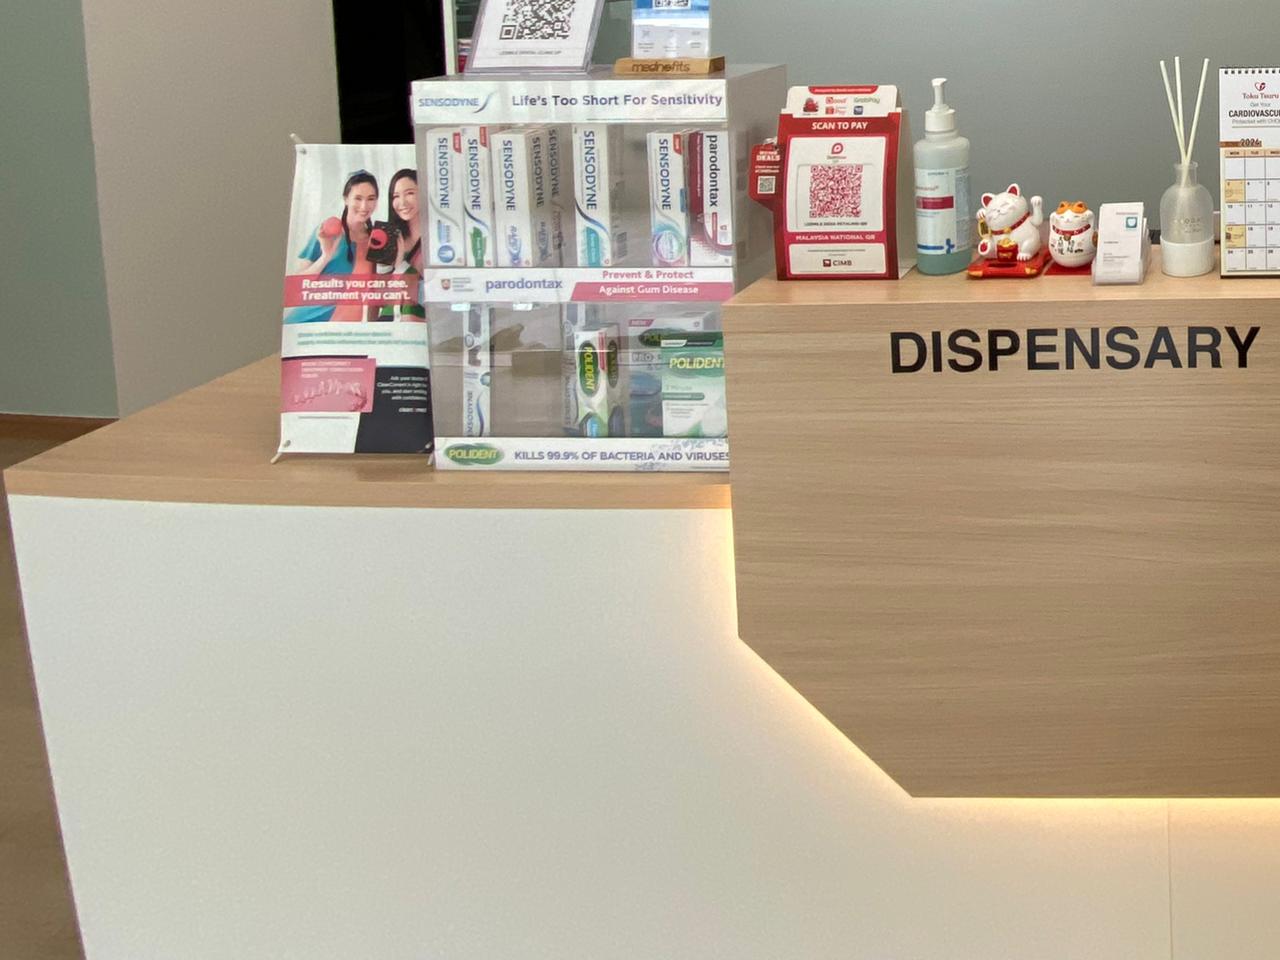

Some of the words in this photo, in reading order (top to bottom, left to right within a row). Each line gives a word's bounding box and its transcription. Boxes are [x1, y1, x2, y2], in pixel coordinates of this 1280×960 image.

[632, 61, 690, 72] mednefits
[418, 98, 480, 107] SENSODYNE
[512, 95, 547, 106] Life's
[552, 95, 578, 106] Too
[583, 95, 619, 106] Short
[623, 94, 647, 105] For
[651, 93, 723, 107] Sensitivity
[812, 121, 836, 130] SCAN
[837, 121, 849, 130] TO
[851, 121, 868, 130] PAY
[438, 137, 450, 209] SENSODYNE
[467, 139, 482, 211] SENSODYNE
[503, 140, 516, 211] SENSODYNE
[531, 136, 545, 209] SENSODYNE
[584, 130, 598, 210] SENSODYNE
[659, 138, 672, 210] SENSODYNE
[706, 135, 720, 207] parodontax
[602, 270, 642, 280] Prevent
[645, 270, 652, 279] &
[656, 270, 694, 279] Protect
[302, 279, 344, 289] Results
[346, 280, 365, 290] you
[367, 280, 386, 289] can
[387, 279, 409, 289] see.
[485, 278, 563, 293] parodontax
[599, 285, 635, 296] Against
[637, 285, 661, 295] Gum
[662, 285, 699, 294] Disease
[302, 290, 359, 300] Treatment
[361, 291, 381, 302] you
[890, 325, 1261, 374] DISPENSARY
[584, 346, 595, 391] POLIDENT
[448, 449, 498, 459] POLIDENT
[515, 451, 544, 461] KILLS
[547, 451, 579, 461] 99.9%
[581, 451, 598, 461] OF
[600, 451, 655, 461] BACTERIA
[657, 451, 683, 461] AND
